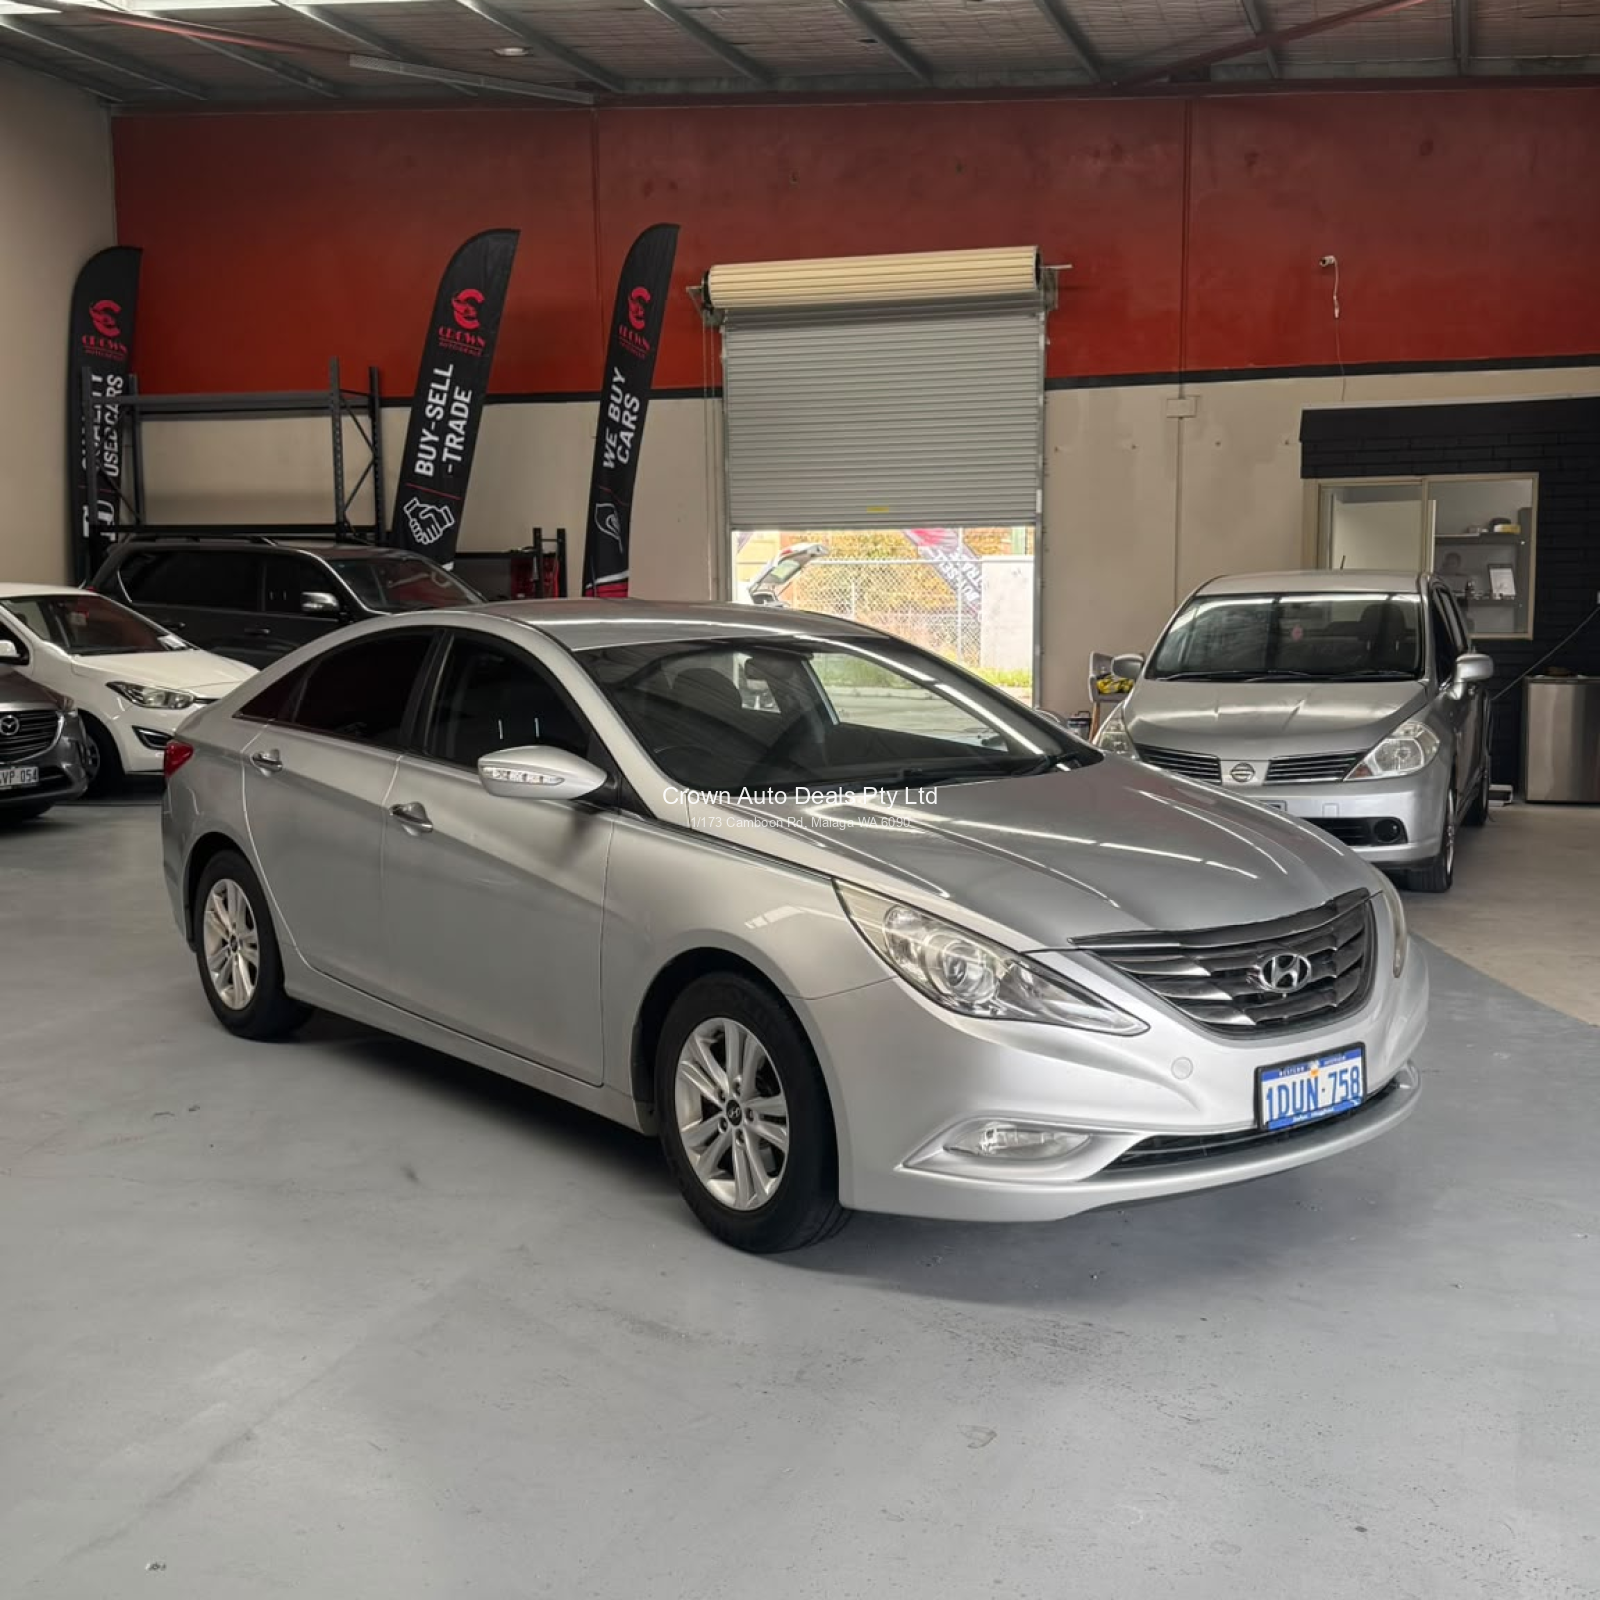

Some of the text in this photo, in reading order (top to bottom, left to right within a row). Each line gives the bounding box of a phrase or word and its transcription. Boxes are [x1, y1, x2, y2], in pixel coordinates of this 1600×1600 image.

[414, 364, 454, 477] BUY-SELL
[603, 366, 625, 469] WE BUY
[617, 393, 640, 464] CARS
